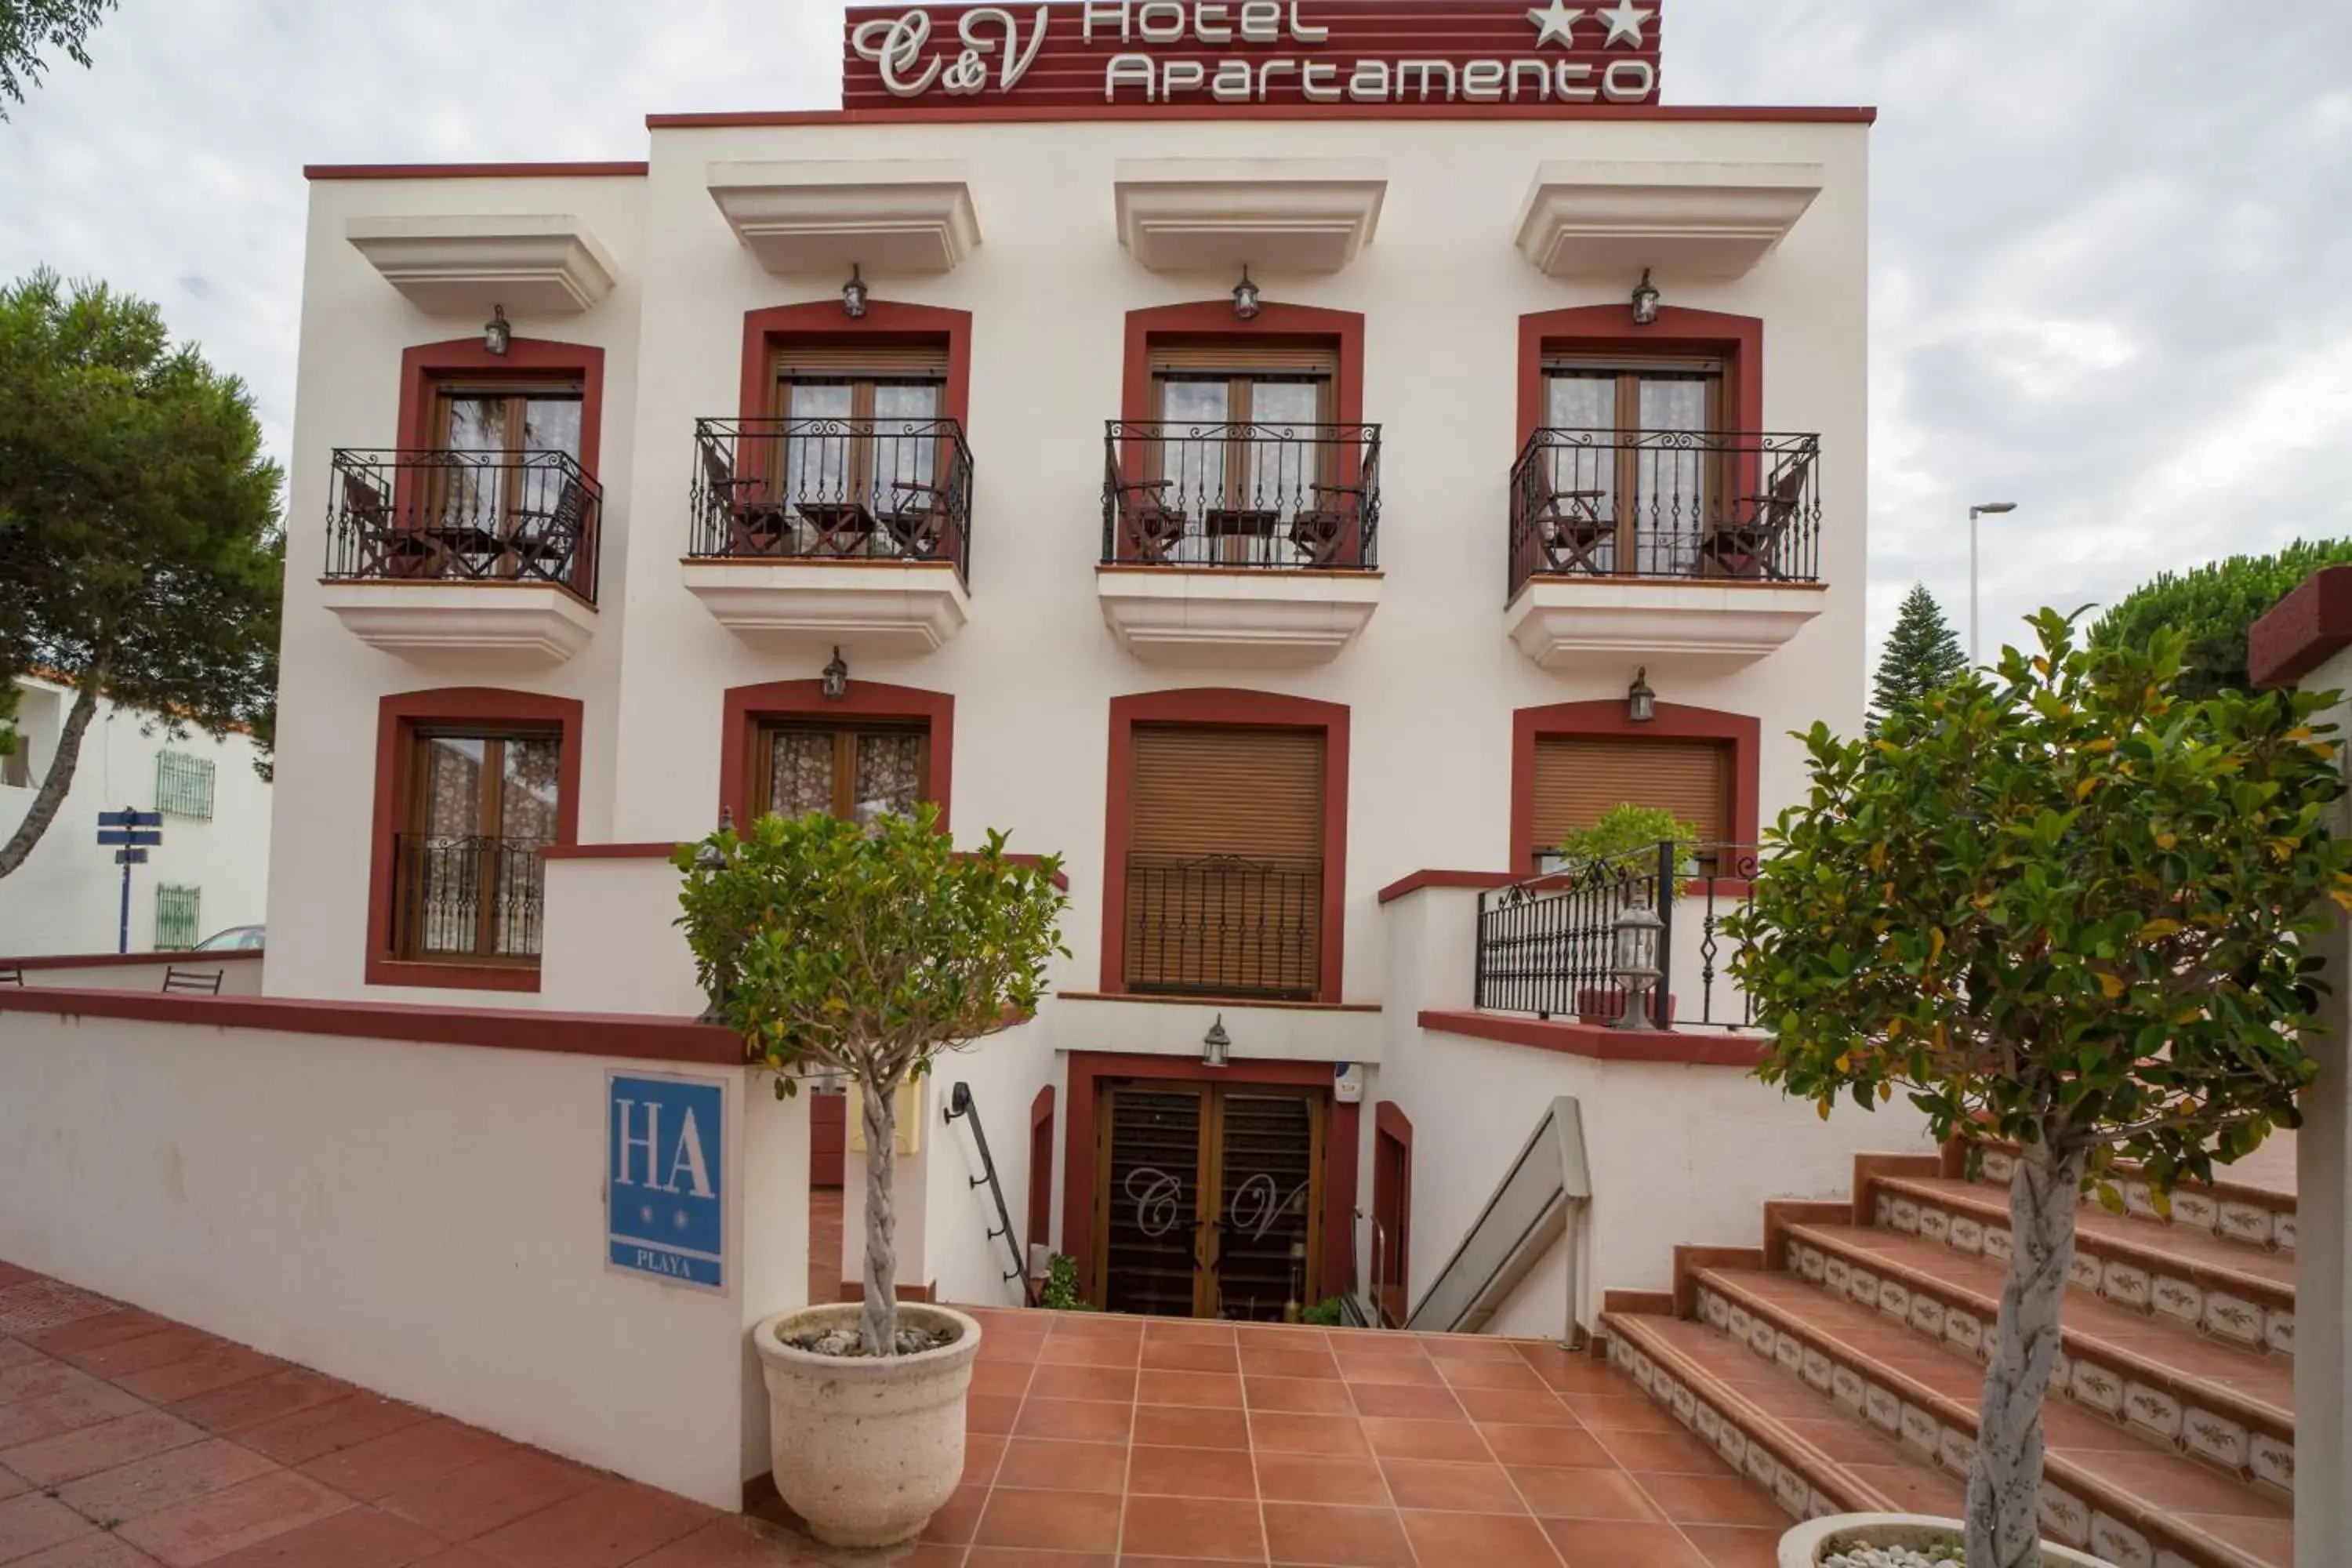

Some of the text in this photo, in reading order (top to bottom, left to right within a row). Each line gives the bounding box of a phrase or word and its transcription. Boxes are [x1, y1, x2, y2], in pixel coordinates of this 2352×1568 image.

[1083, 0, 1329, 44] Hotel
[1105, 53, 1653, 103] Apartamento
[615, 1098, 716, 1199] HA
[636, 1249, 691, 1278] PLAYA
